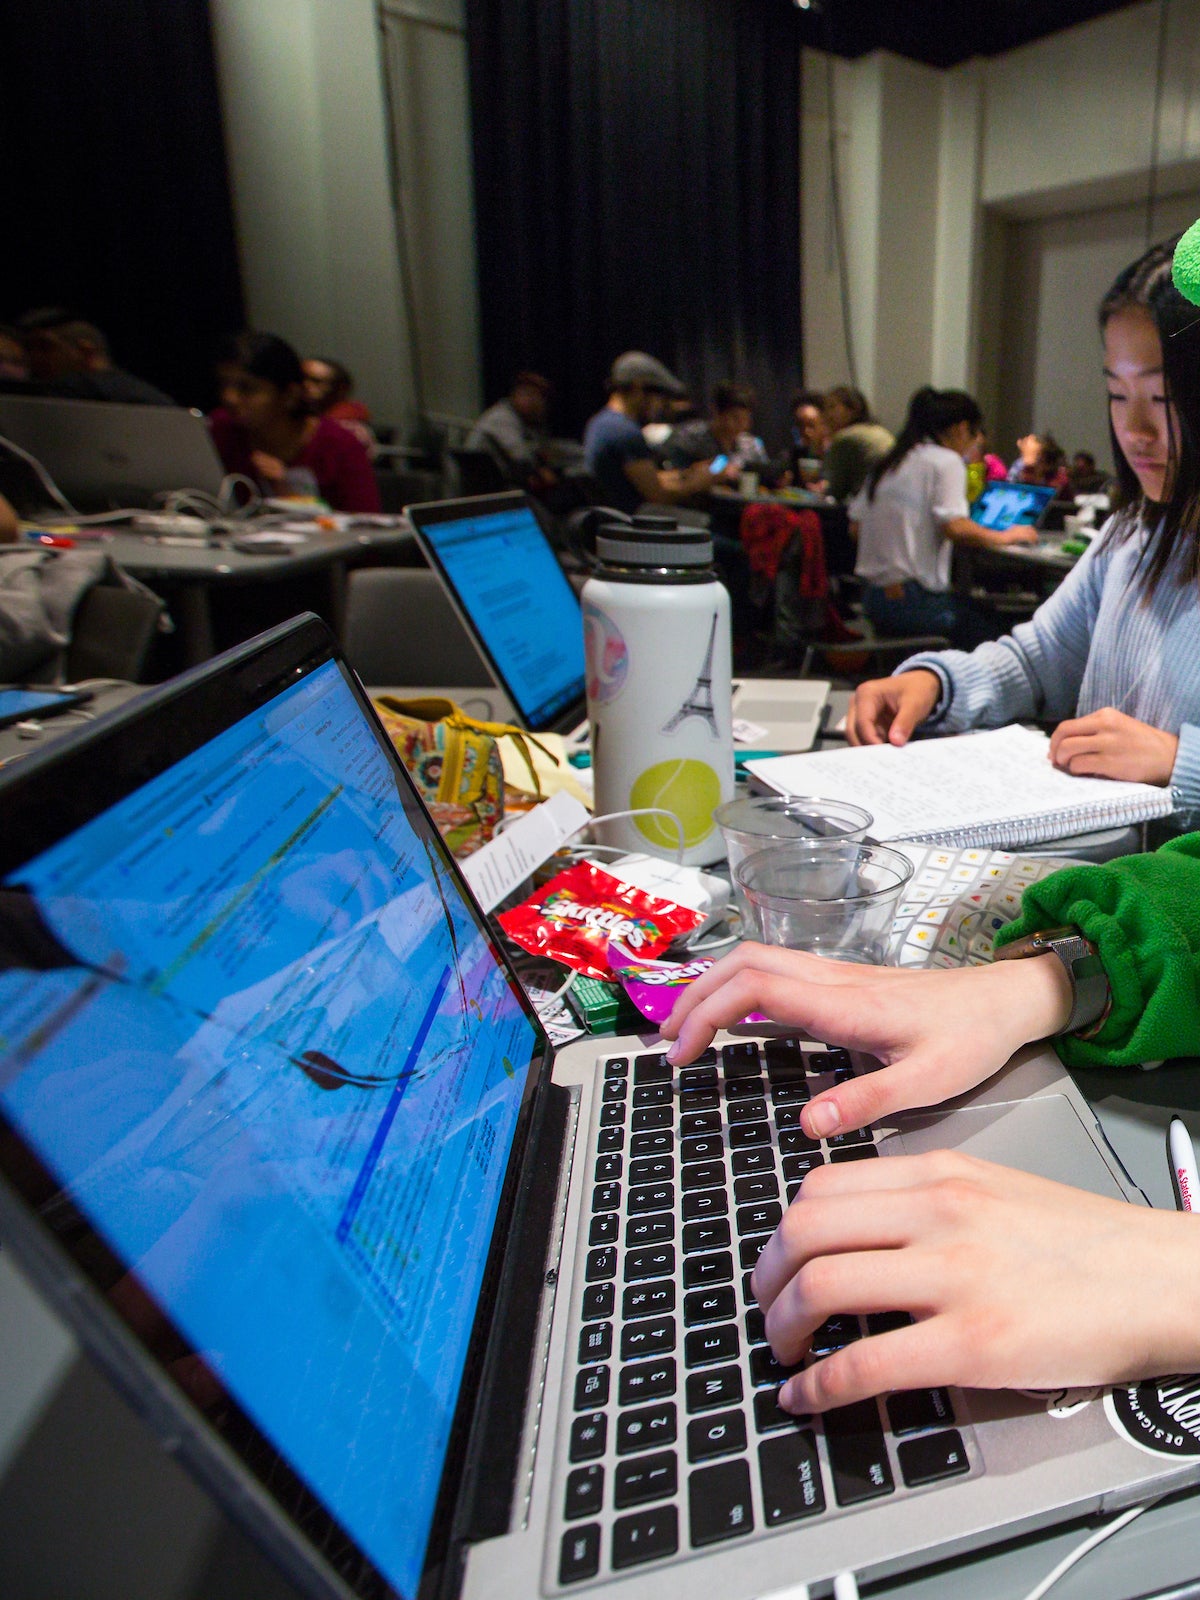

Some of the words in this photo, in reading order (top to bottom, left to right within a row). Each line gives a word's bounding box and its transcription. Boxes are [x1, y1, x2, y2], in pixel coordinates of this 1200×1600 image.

[540, 899, 647, 948] Skittles
[798, 1160, 811, 1169] M
[753, 1212, 766, 1220] H
[632, 1295, 645, 1304] %
[703, 1299, 717, 1308] R
[827, 1321, 842, 1332] X
[705, 1339, 720, 1347] E
[651, 1372, 666, 1380] 3
[706, 1380, 722, 1394] W
[650, 1417, 667, 1427] 2
[627, 1423, 642, 1434] @
[708, 1425, 725, 1439] Q
[1135, 1411, 1184, 1447] DESIGN
[650, 1468, 666, 1478] 1
